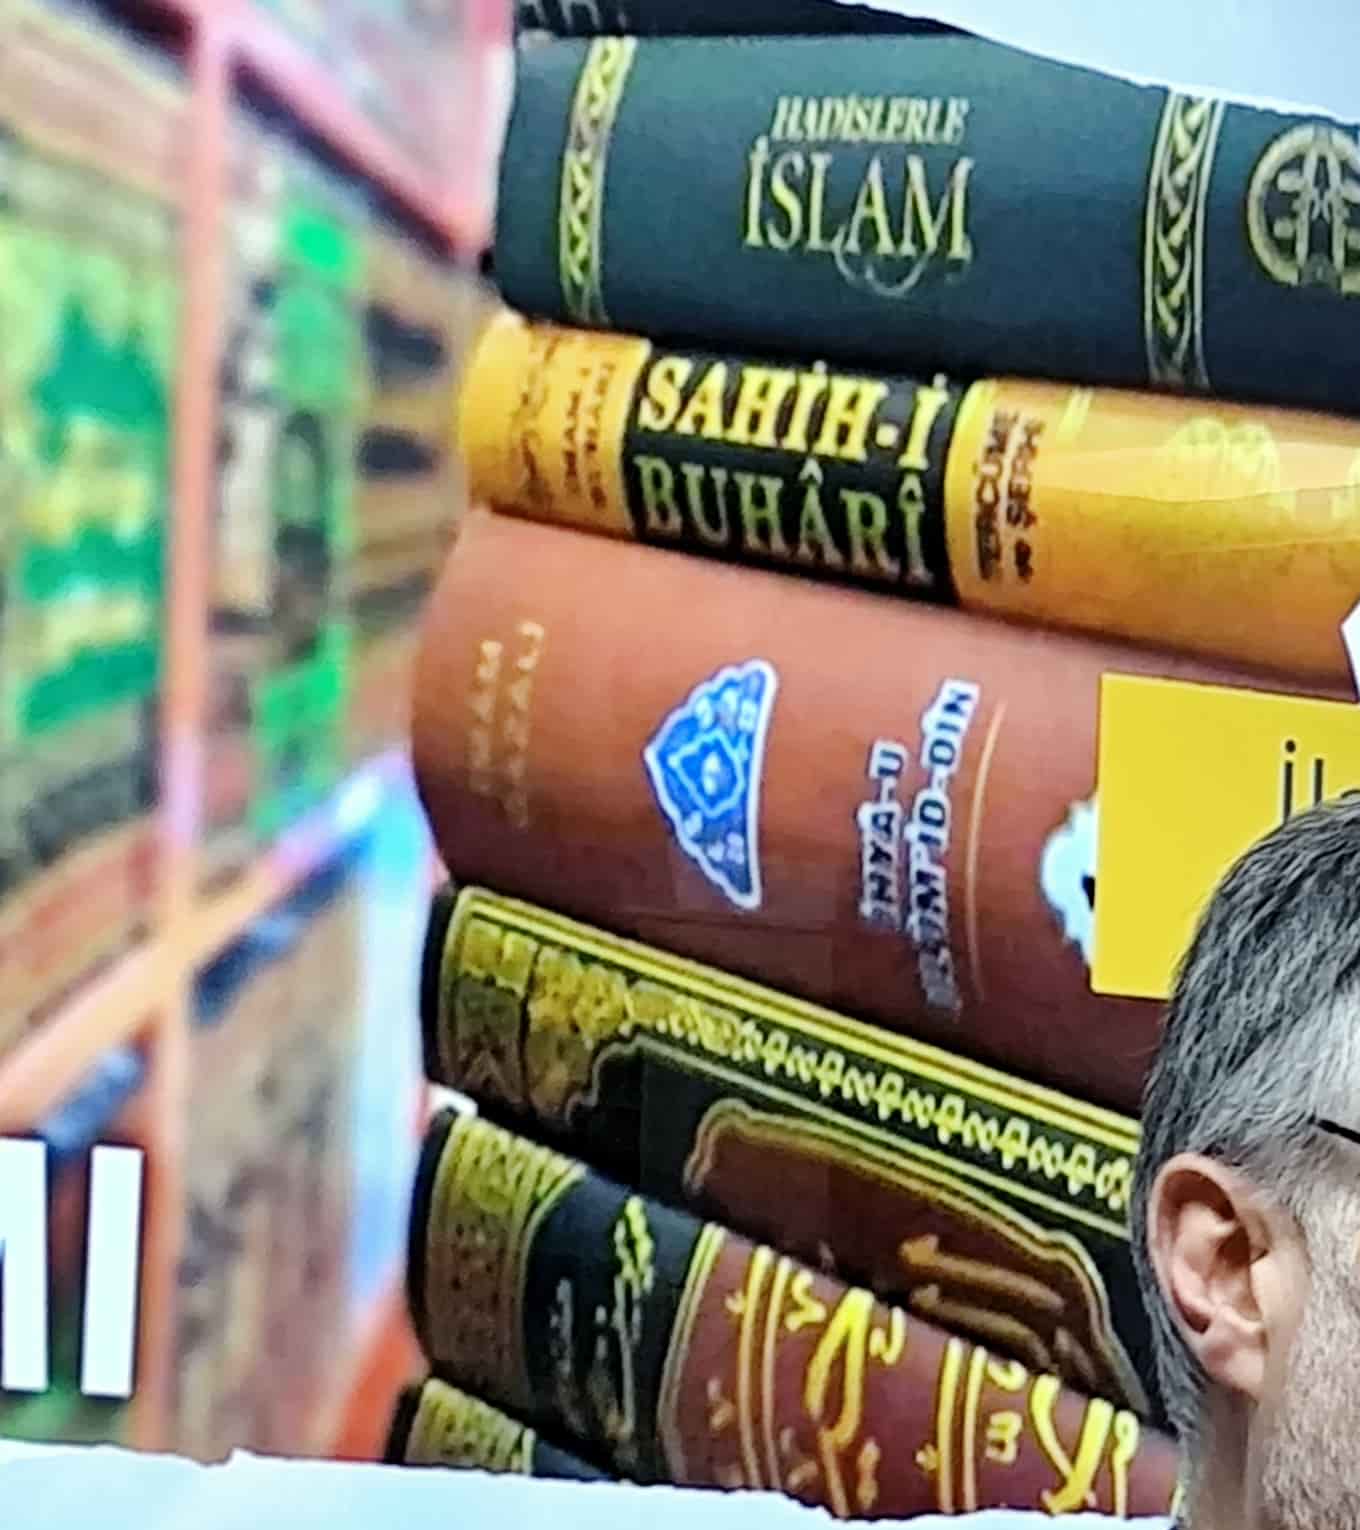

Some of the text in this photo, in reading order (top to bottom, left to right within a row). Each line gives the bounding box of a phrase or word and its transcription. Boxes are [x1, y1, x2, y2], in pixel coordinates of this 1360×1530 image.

[743, 135, 974, 262] İSLAM
[637, 356, 951, 471] SAHİH-İ
[632, 456, 936, 586] BUHÂRÎ
